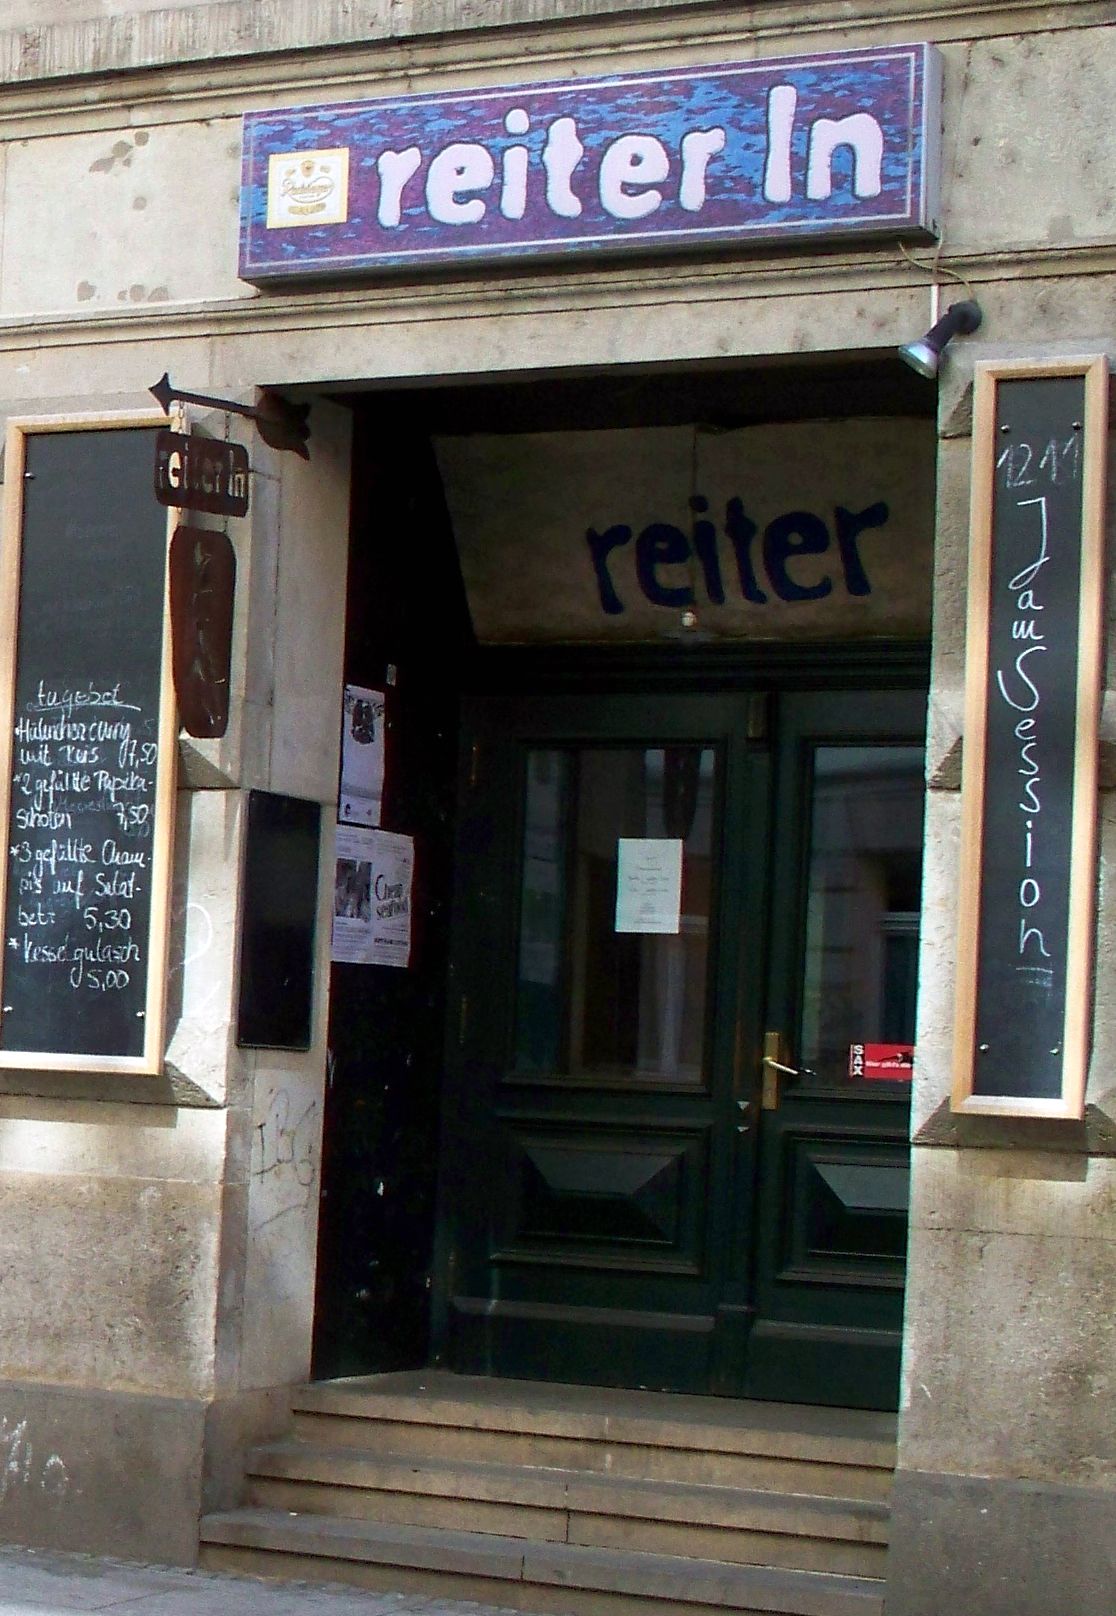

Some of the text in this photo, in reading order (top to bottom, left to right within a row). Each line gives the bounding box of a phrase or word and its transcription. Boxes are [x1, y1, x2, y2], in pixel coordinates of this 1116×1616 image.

[376, 109, 726, 228] reiter
[586, 495, 889, 615] reiter
[113, 801, 149, 831] 7,50
[19, 841, 32, 863] 3
[83, 906, 132, 932] 5,30
[87, 969, 130, 992] 5,00
